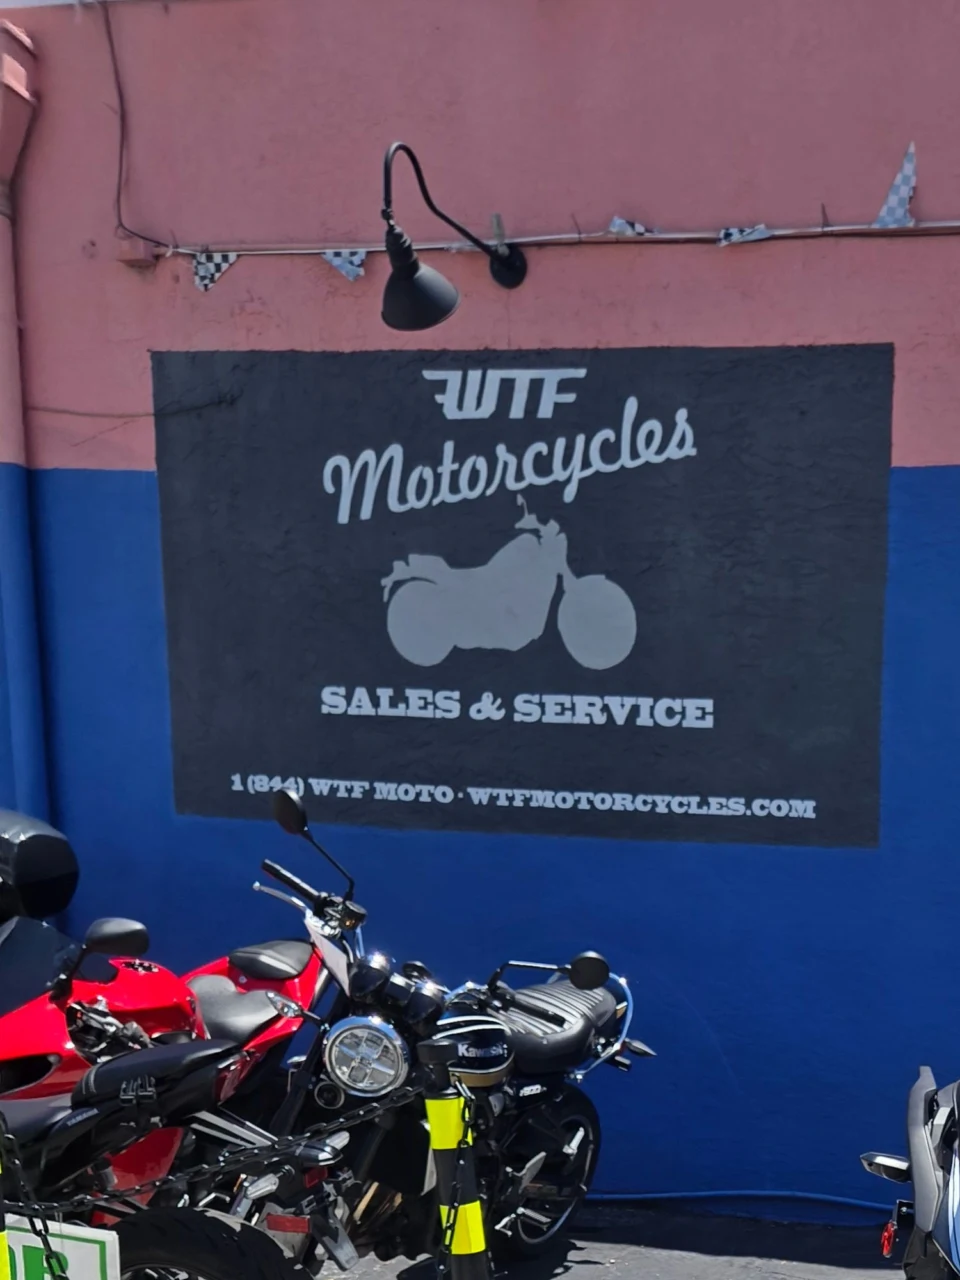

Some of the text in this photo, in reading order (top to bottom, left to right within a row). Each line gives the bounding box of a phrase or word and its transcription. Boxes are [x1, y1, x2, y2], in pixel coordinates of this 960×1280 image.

[422, 368, 588, 420] WTF
[322, 396, 698, 524] Motorcycles
[321, 686, 714, 728] SALES & SERVICE
[308, 778, 370, 798] WTF
[373, 782, 454, 804] MOTO
[466, 787, 816, 818] WTFMOTORCYCLES.COM
